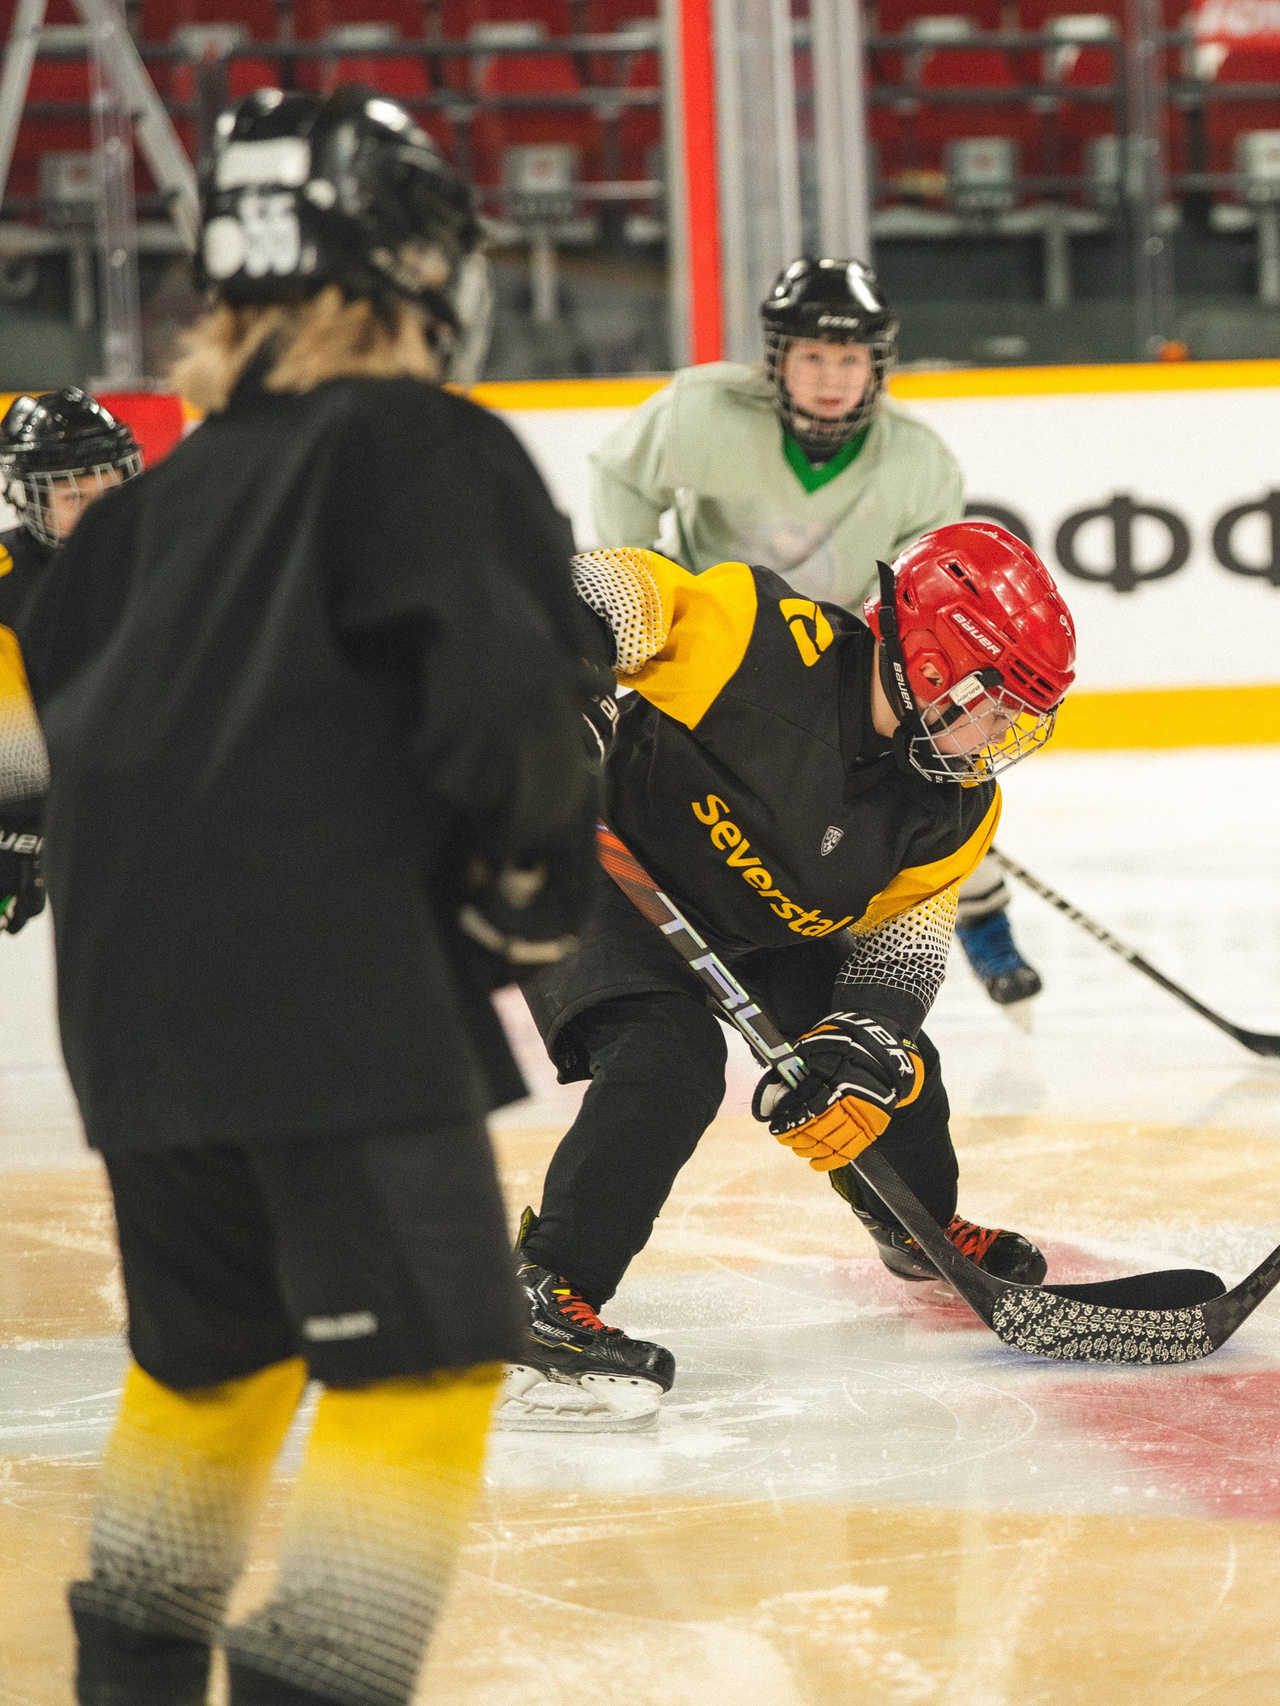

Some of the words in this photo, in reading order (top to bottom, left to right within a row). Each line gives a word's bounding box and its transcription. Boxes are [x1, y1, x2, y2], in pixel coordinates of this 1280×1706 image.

[952, 613, 1001, 656] BAUER
[893, 661, 914, 711] BAUER
[691, 794, 854, 937] Severstal
